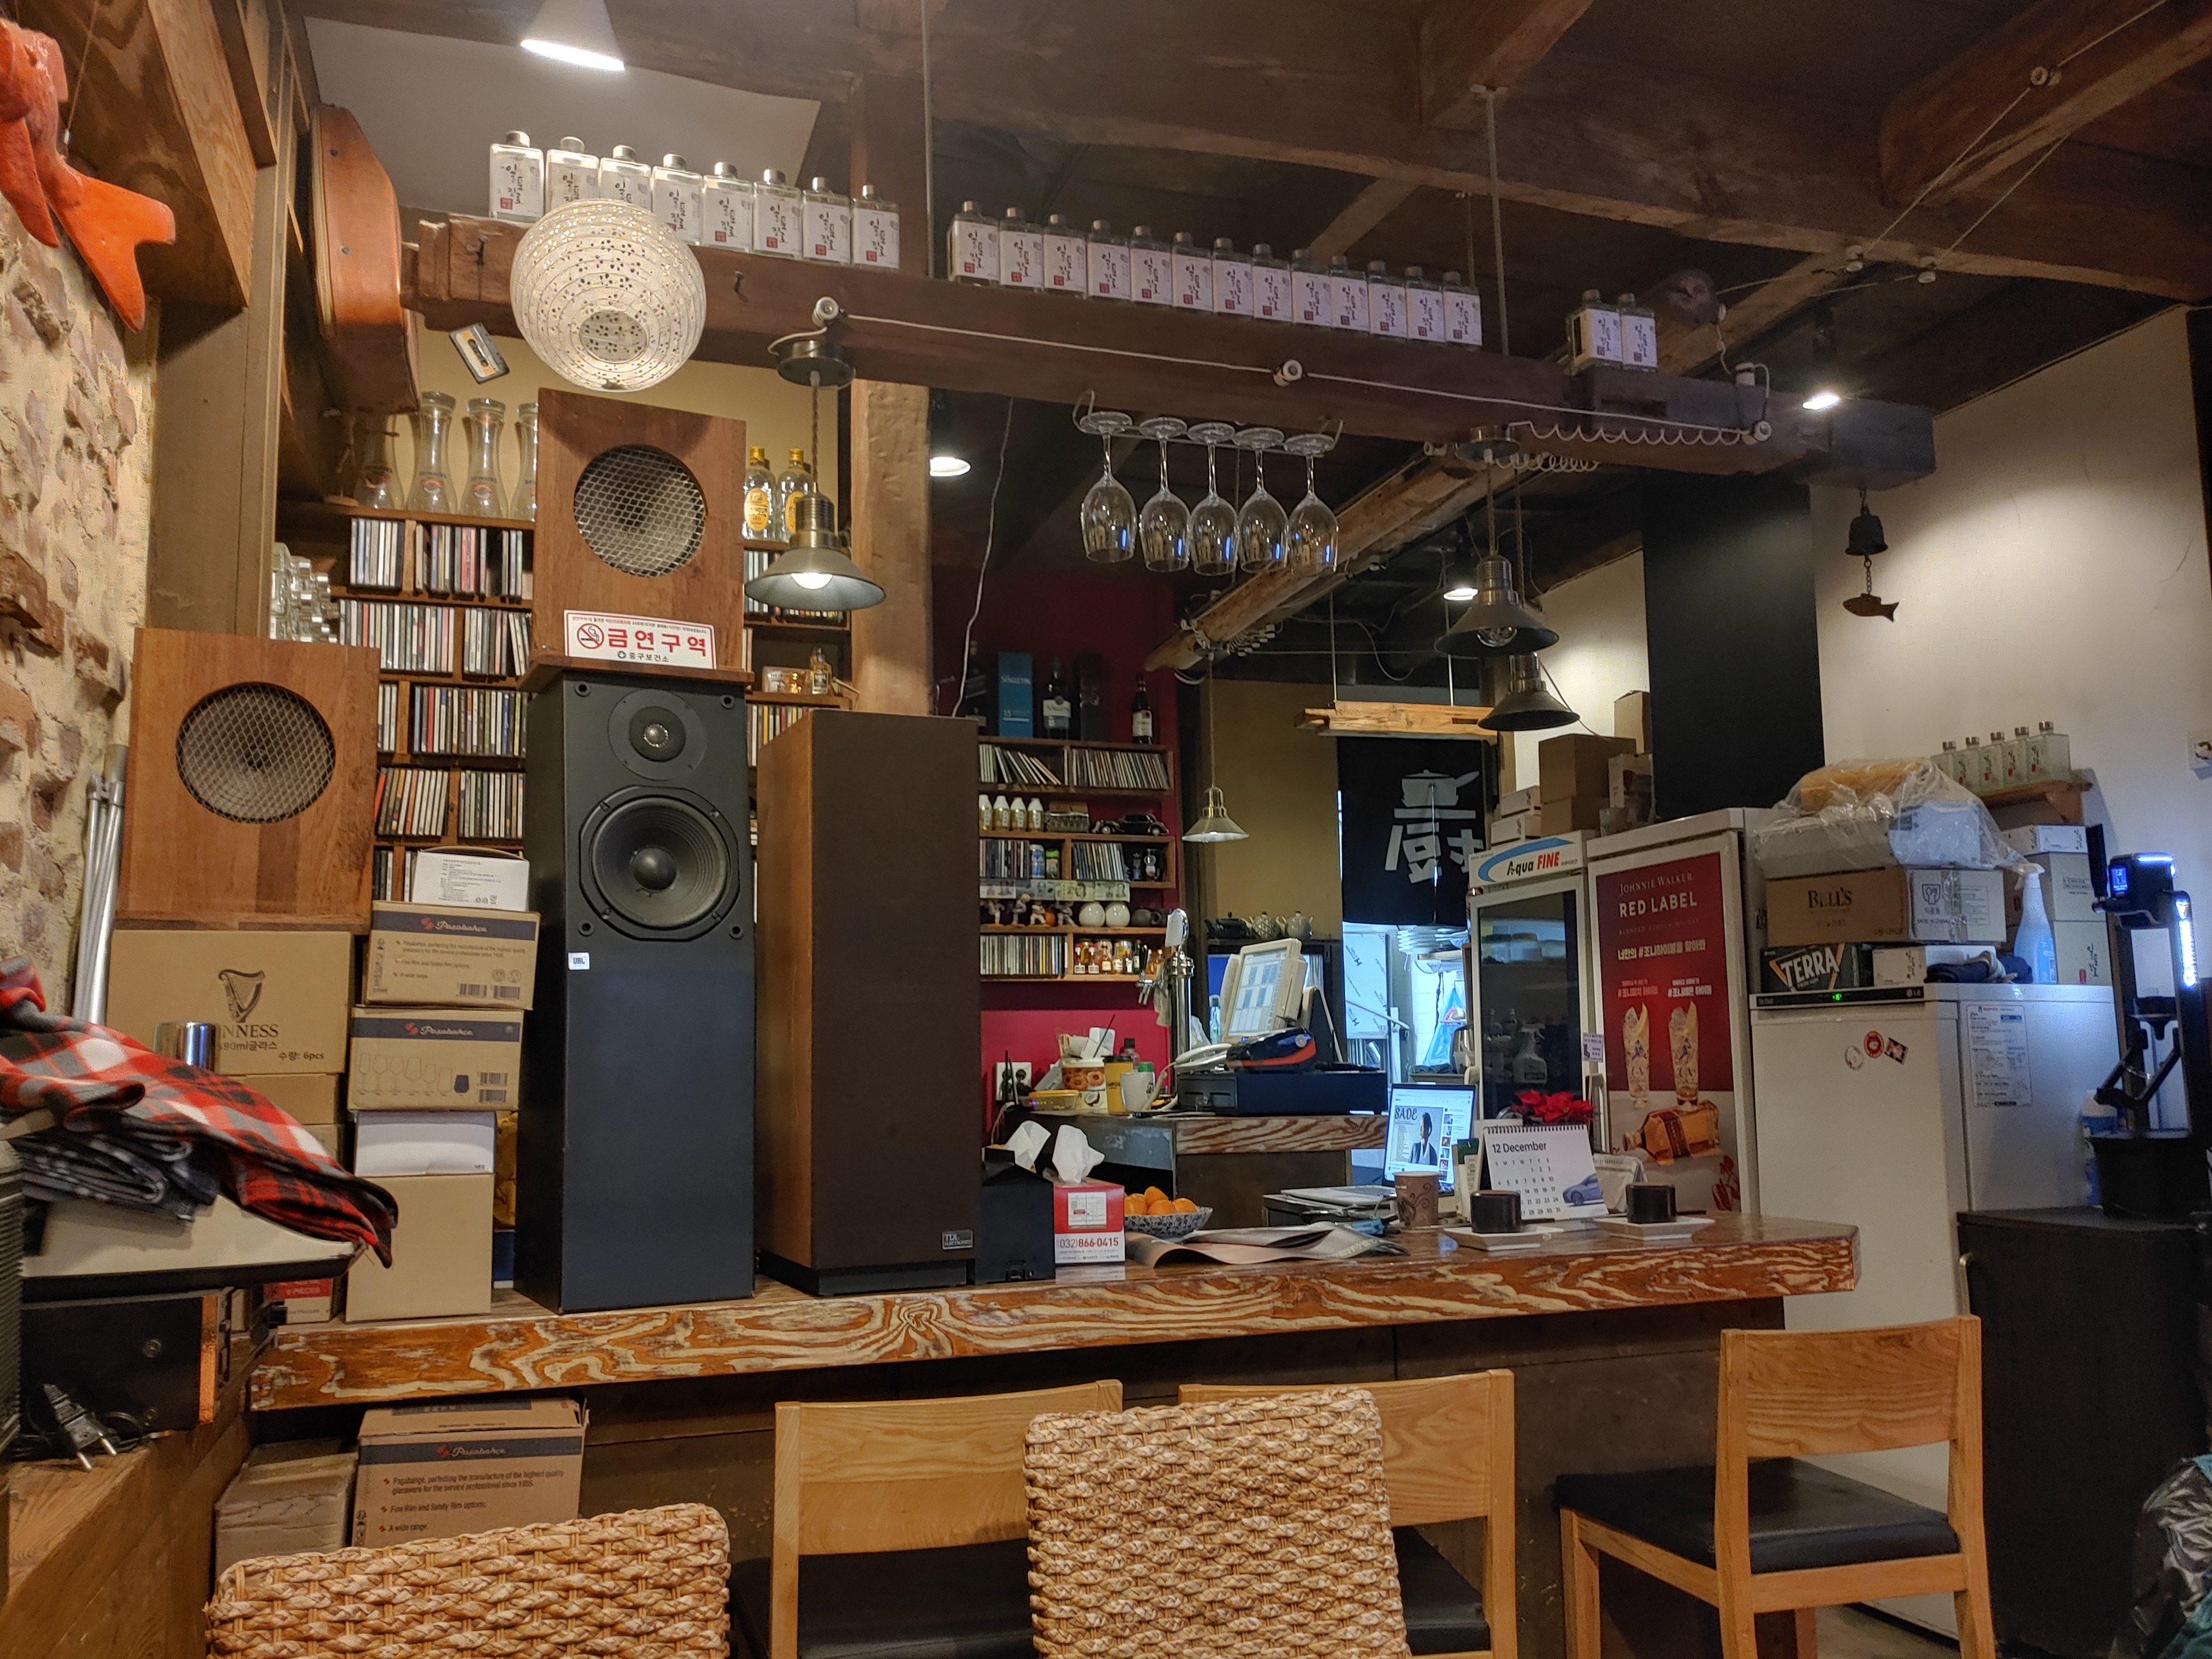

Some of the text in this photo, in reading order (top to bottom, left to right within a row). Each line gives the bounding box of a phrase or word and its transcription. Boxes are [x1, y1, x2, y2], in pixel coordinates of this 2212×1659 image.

[608, 628, 706, 657] 금연구역
[629, 652, 669, 662] 중구보건소
[1507, 860, 1534, 876] Aqua
[1537, 852, 1560, 870] FINE
[1620, 891, 1697, 918] RED LABEL
[1618, 947, 1637, 961] 너만의
[1780, 947, 1840, 988] TERRA
[222, 1024, 279, 1037] NNESS
[279, 1052, 324, 1061] 수량: 6pcs
[1395, 1107, 1418, 1121] SADE
[1492, 1141, 1547, 1153] 12 December
[428, 1475, 456, 1484] perfecting
[469, 1472, 505, 1481] manufacture
[523, 1470, 544, 1480] highest
[546, 1470, 564, 1478] quality
[390, 1505, 403, 1513] Fine
